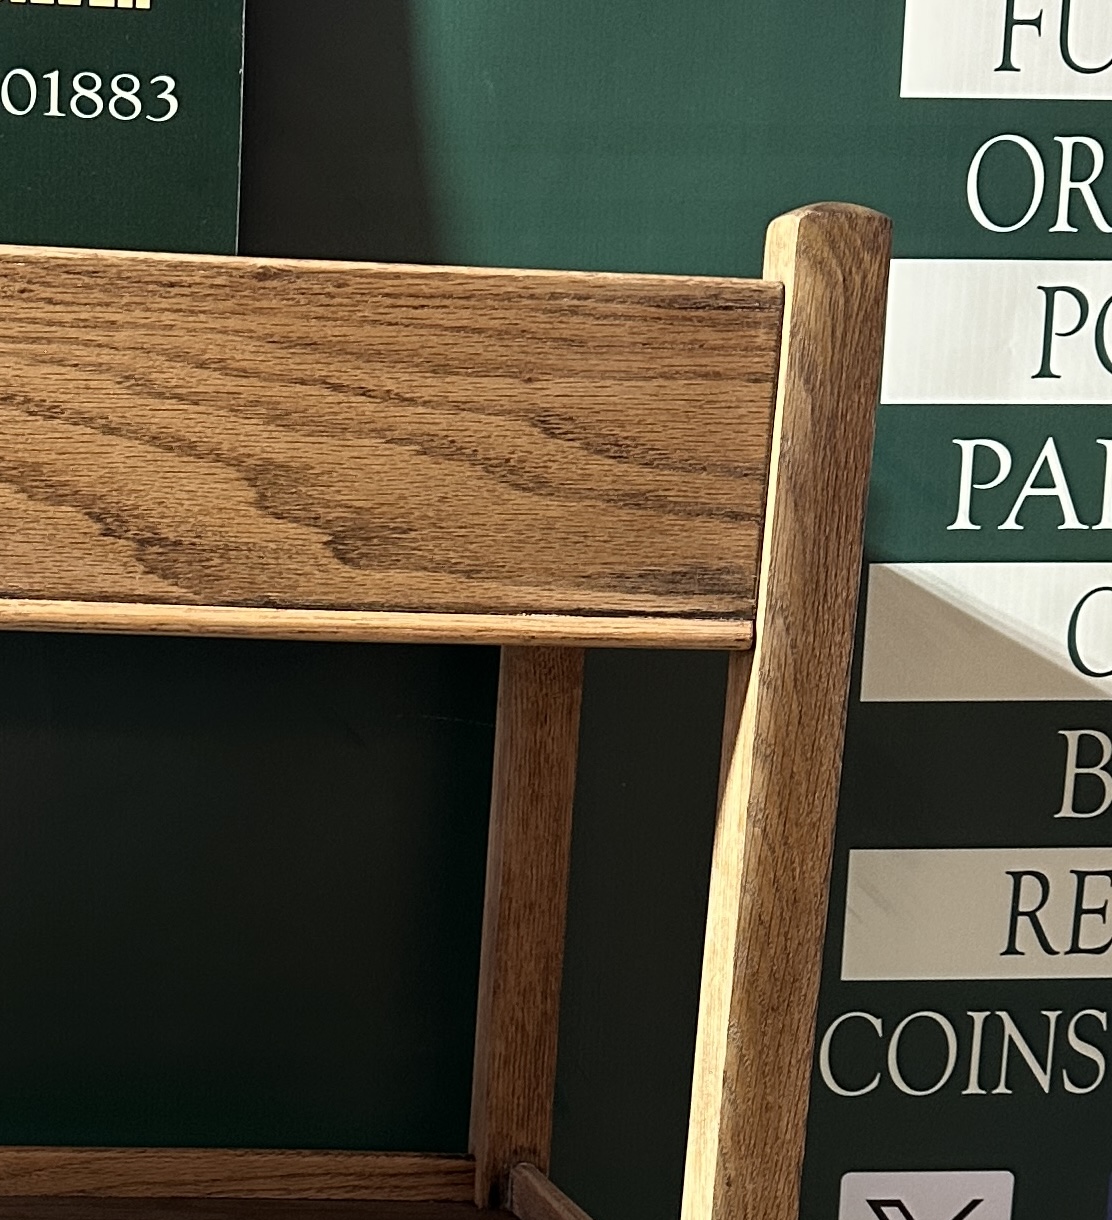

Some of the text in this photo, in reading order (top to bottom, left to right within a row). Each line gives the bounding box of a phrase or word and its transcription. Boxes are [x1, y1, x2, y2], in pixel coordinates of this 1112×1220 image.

[966, 133, 1112, 233] OR
[999, 869, 1112, 956] RE
[819, 1009, 1108, 1097] COINS
